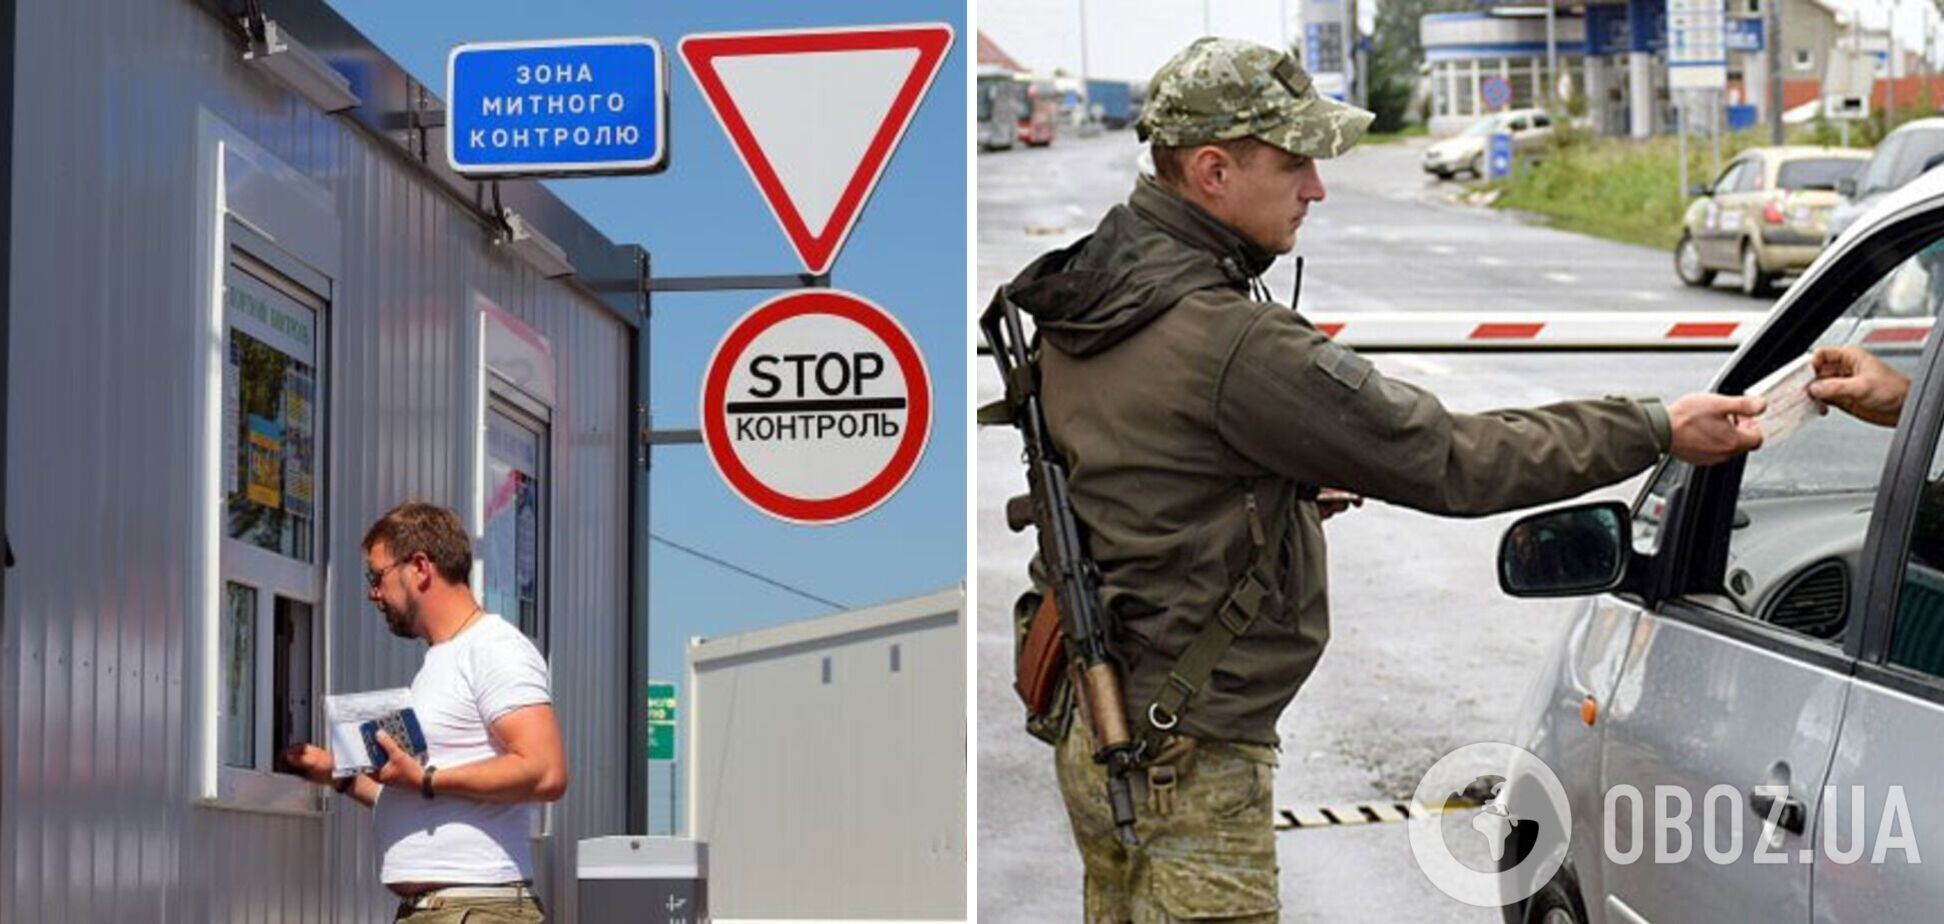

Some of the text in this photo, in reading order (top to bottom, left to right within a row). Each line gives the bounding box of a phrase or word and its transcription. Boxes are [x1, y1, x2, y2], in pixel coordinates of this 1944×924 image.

[516, 63, 593, 84] ЗОНА
[482, 93, 624, 115] МИТНОГО
[470, 126, 639, 148] КОНТРОЛЮ
[748, 351, 884, 398] STOP
[736, 412, 900, 441] КОНТРОЛЬ
